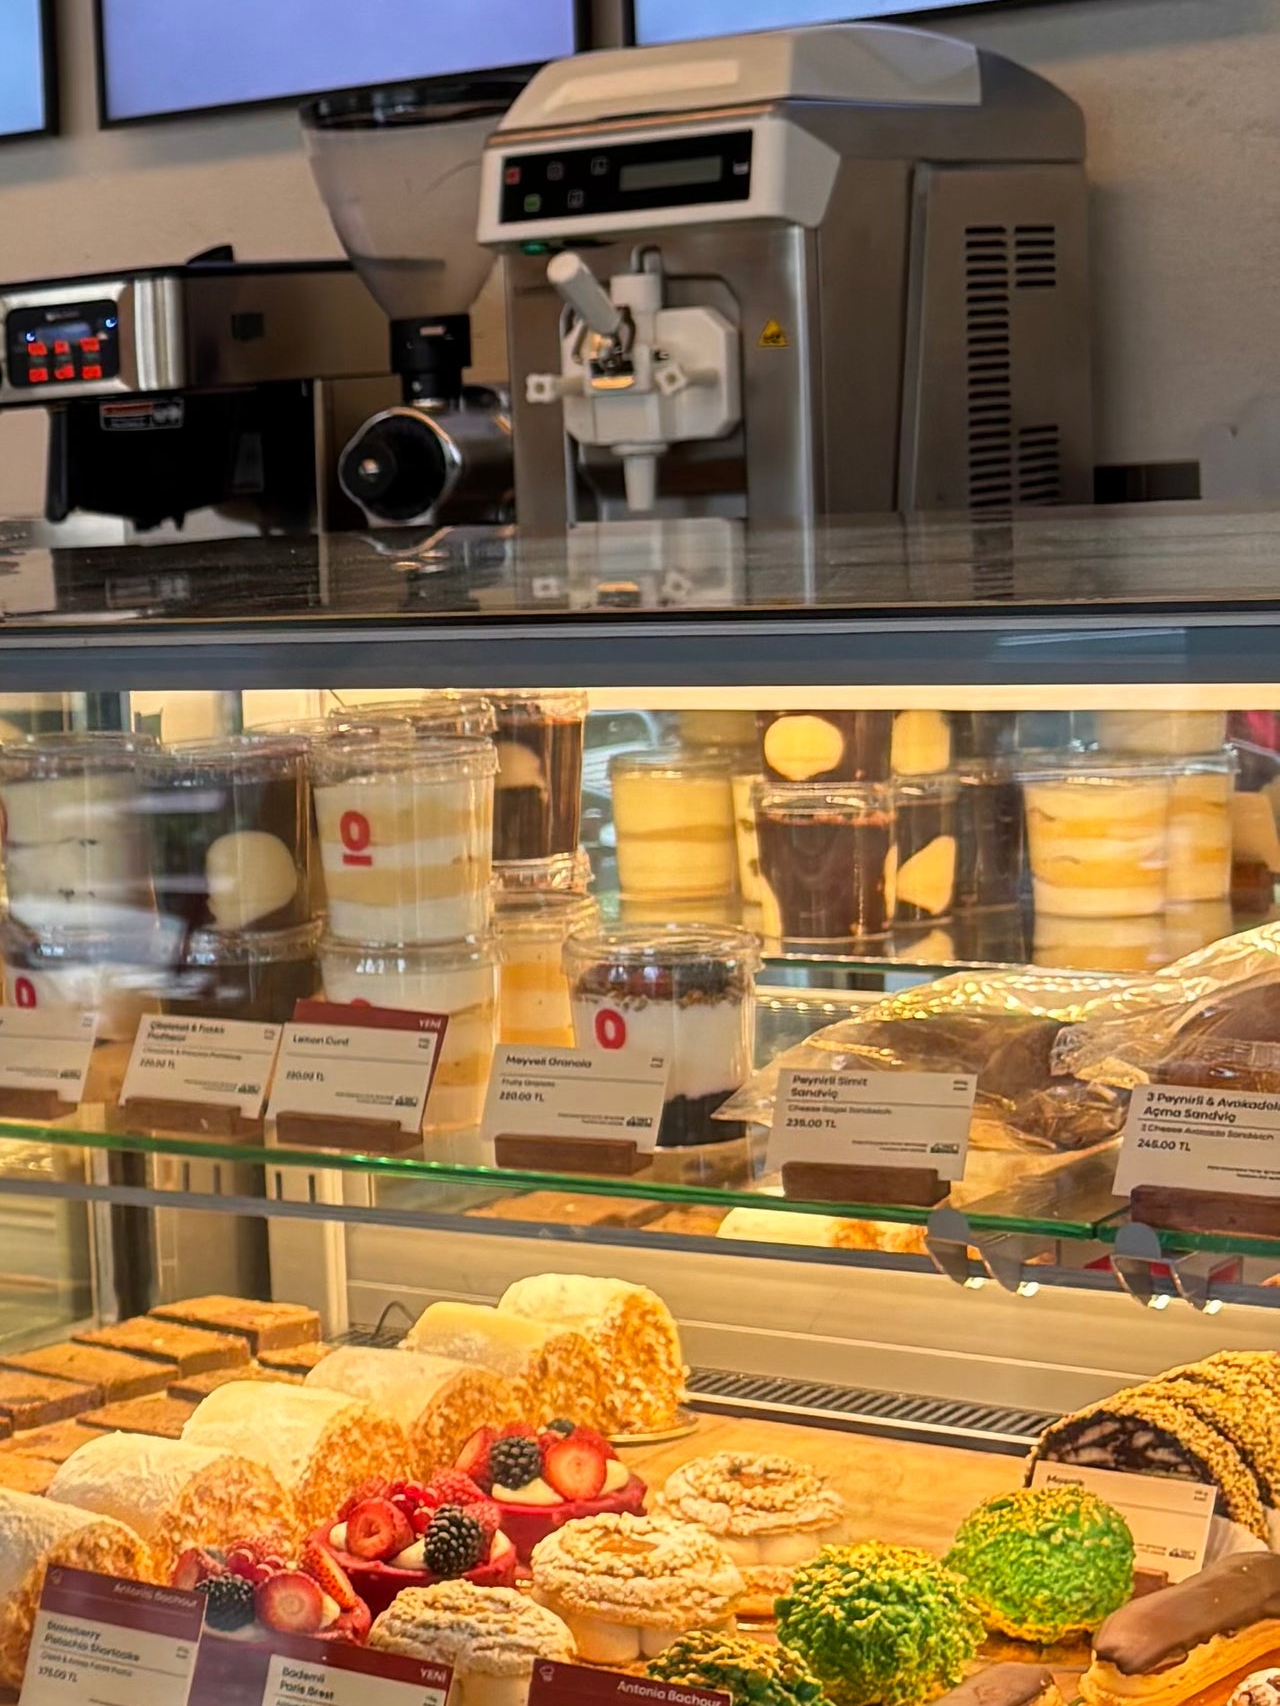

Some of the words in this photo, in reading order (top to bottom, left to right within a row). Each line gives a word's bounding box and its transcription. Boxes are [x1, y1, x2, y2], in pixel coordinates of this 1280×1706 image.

[293, 1034, 324, 1045] Lemon
[506, 1054, 546, 1068] Meyveli
[548, 1057, 592, 1069] Granola
[793, 1075, 836, 1087] Peynirli
[838, 1077, 867, 1087] Simit
[534, 1093, 544, 1102] TL
[791, 1088, 838, 1099] Sandviç
[1147, 1092, 1154, 1102] 3
[1157, 1093, 1203, 1106] Peynirli
[1206, 1097, 1214, 1106] &
[1144, 1106, 1181, 1118] Açma
[1184, 1109, 1236, 1122] Sandviç
[825, 1120, 836, 1128] TL
[1137, 1138, 1176, 1150] 245.00
[1179, 1141, 1191, 1152] TL
[282, 1666, 325, 1684] Bademli
[421, 1667, 447, 1684] YENİ
[280, 1680, 304, 1696] Paris
[307, 1686, 334, 1701] Brest
[617, 1681, 666, 1699] Antonio
